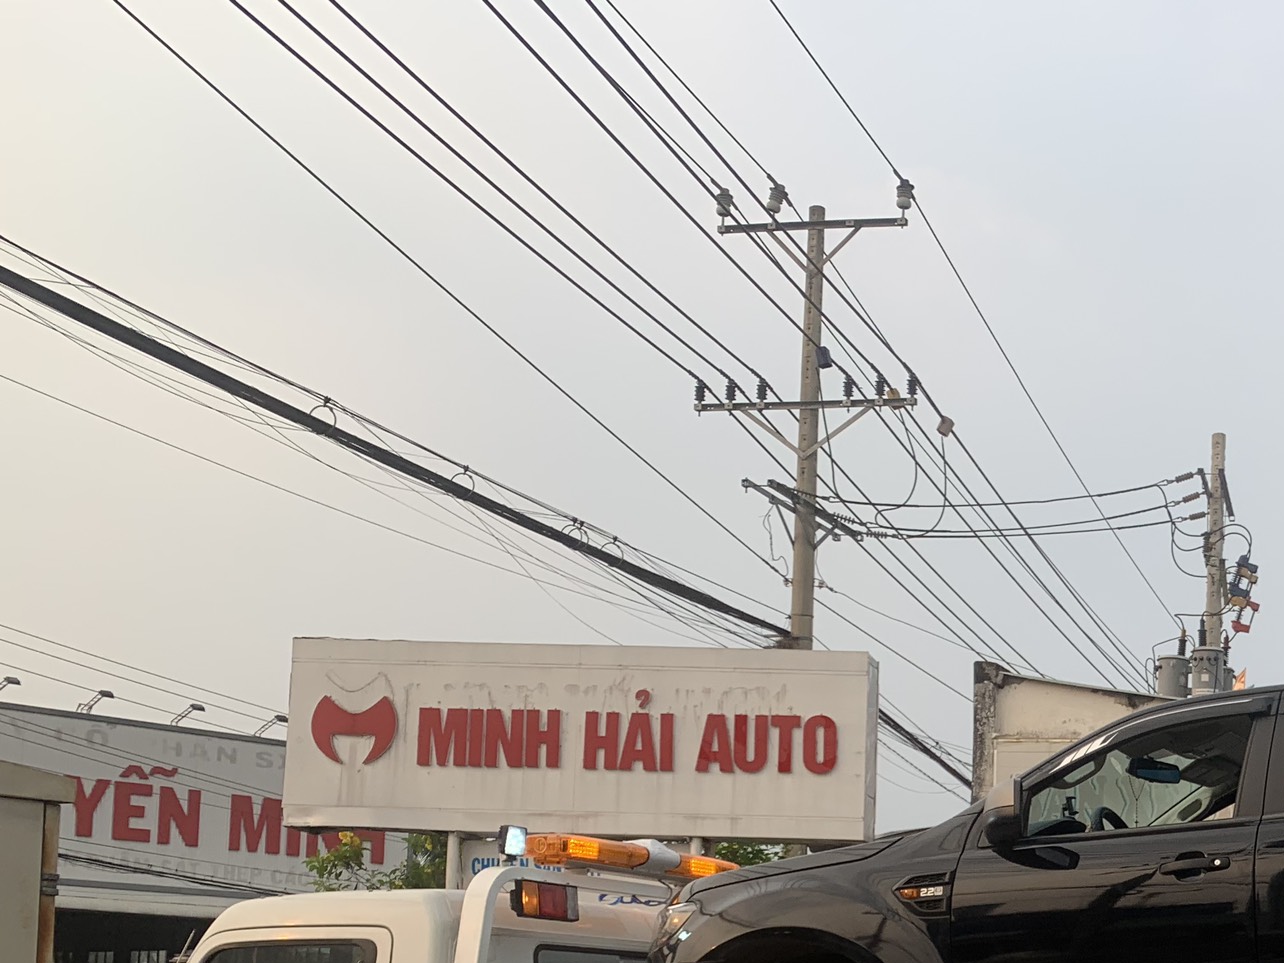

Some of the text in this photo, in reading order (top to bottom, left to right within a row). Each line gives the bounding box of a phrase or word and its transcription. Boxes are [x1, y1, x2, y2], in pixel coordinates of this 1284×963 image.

[416, 689, 839, 775] MINH HẢI AUTO
